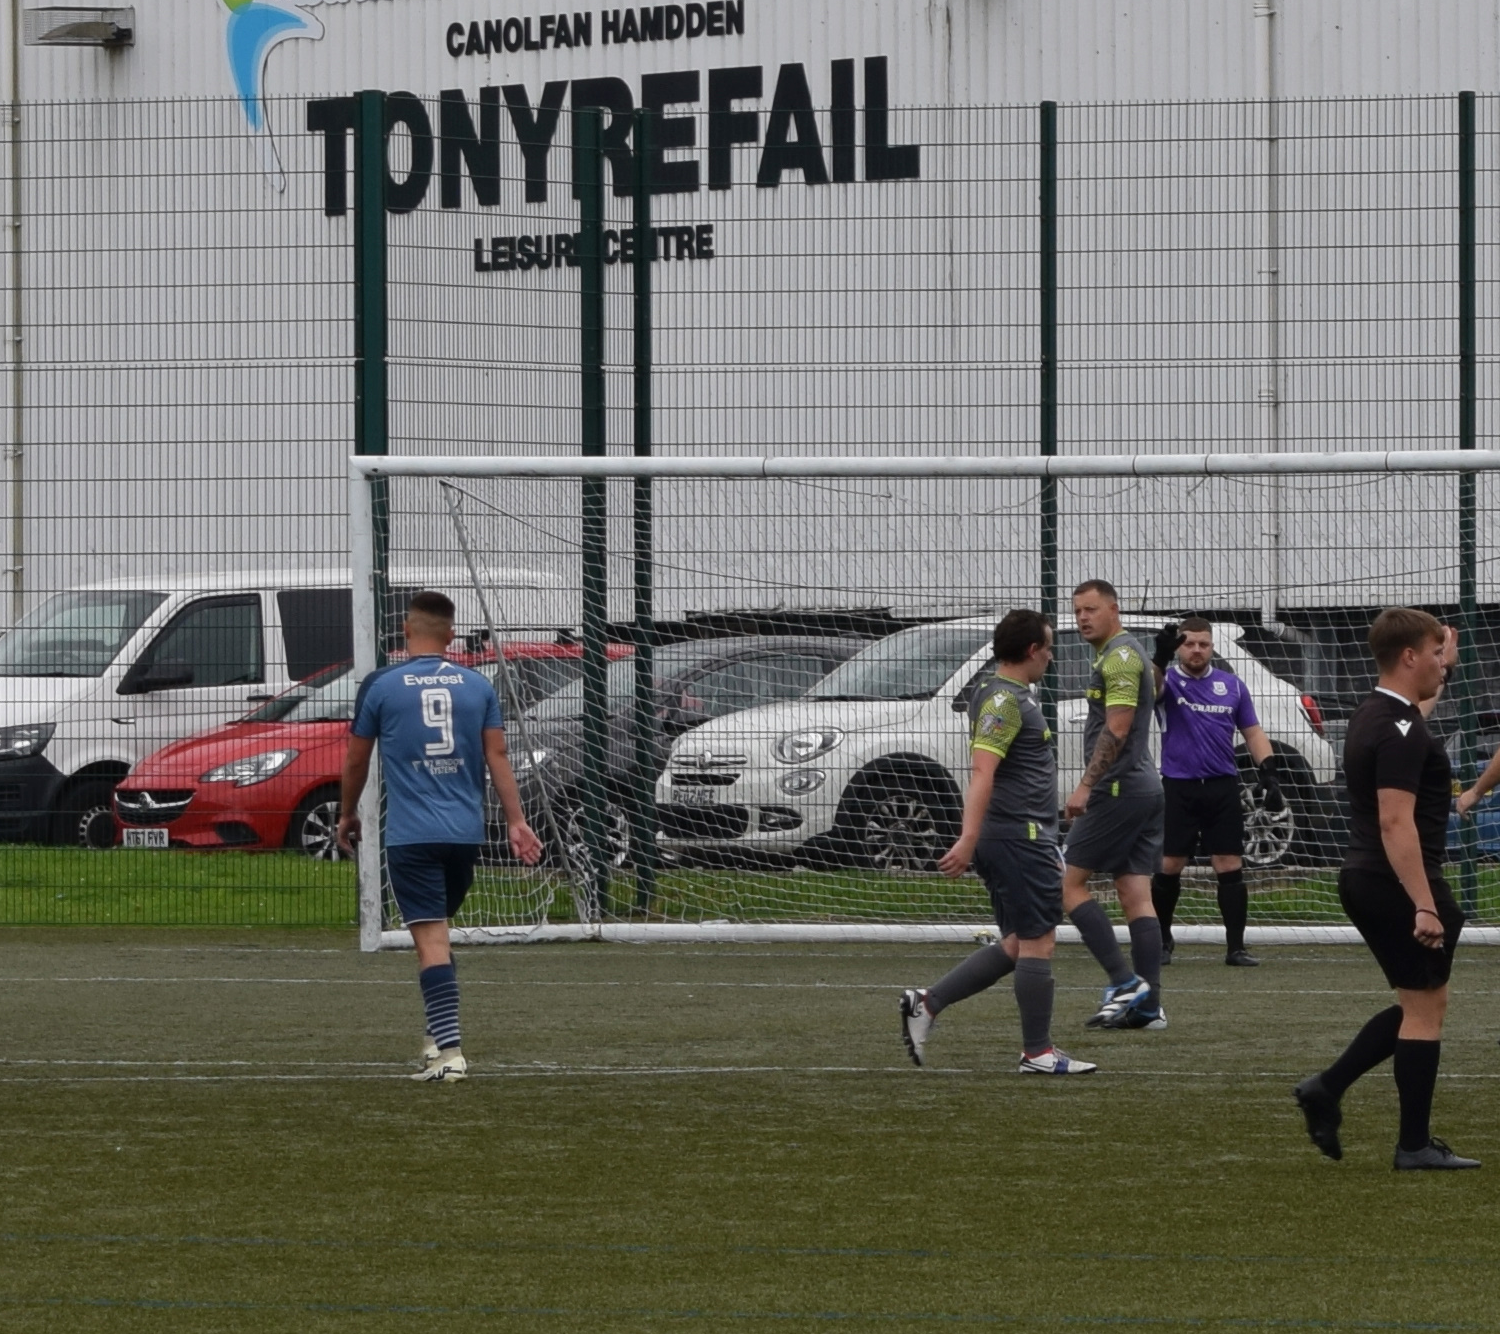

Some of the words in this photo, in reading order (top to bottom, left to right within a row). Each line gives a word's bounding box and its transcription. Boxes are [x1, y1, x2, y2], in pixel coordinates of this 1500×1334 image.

[446, 11, 593, 58] CANOLFAN
[601, 0, 745, 45] HAMDDEN
[307, 56, 921, 216] TONYREFAIL
[403, 673, 464, 686] Everest
[421, 688, 454, 756] 9
